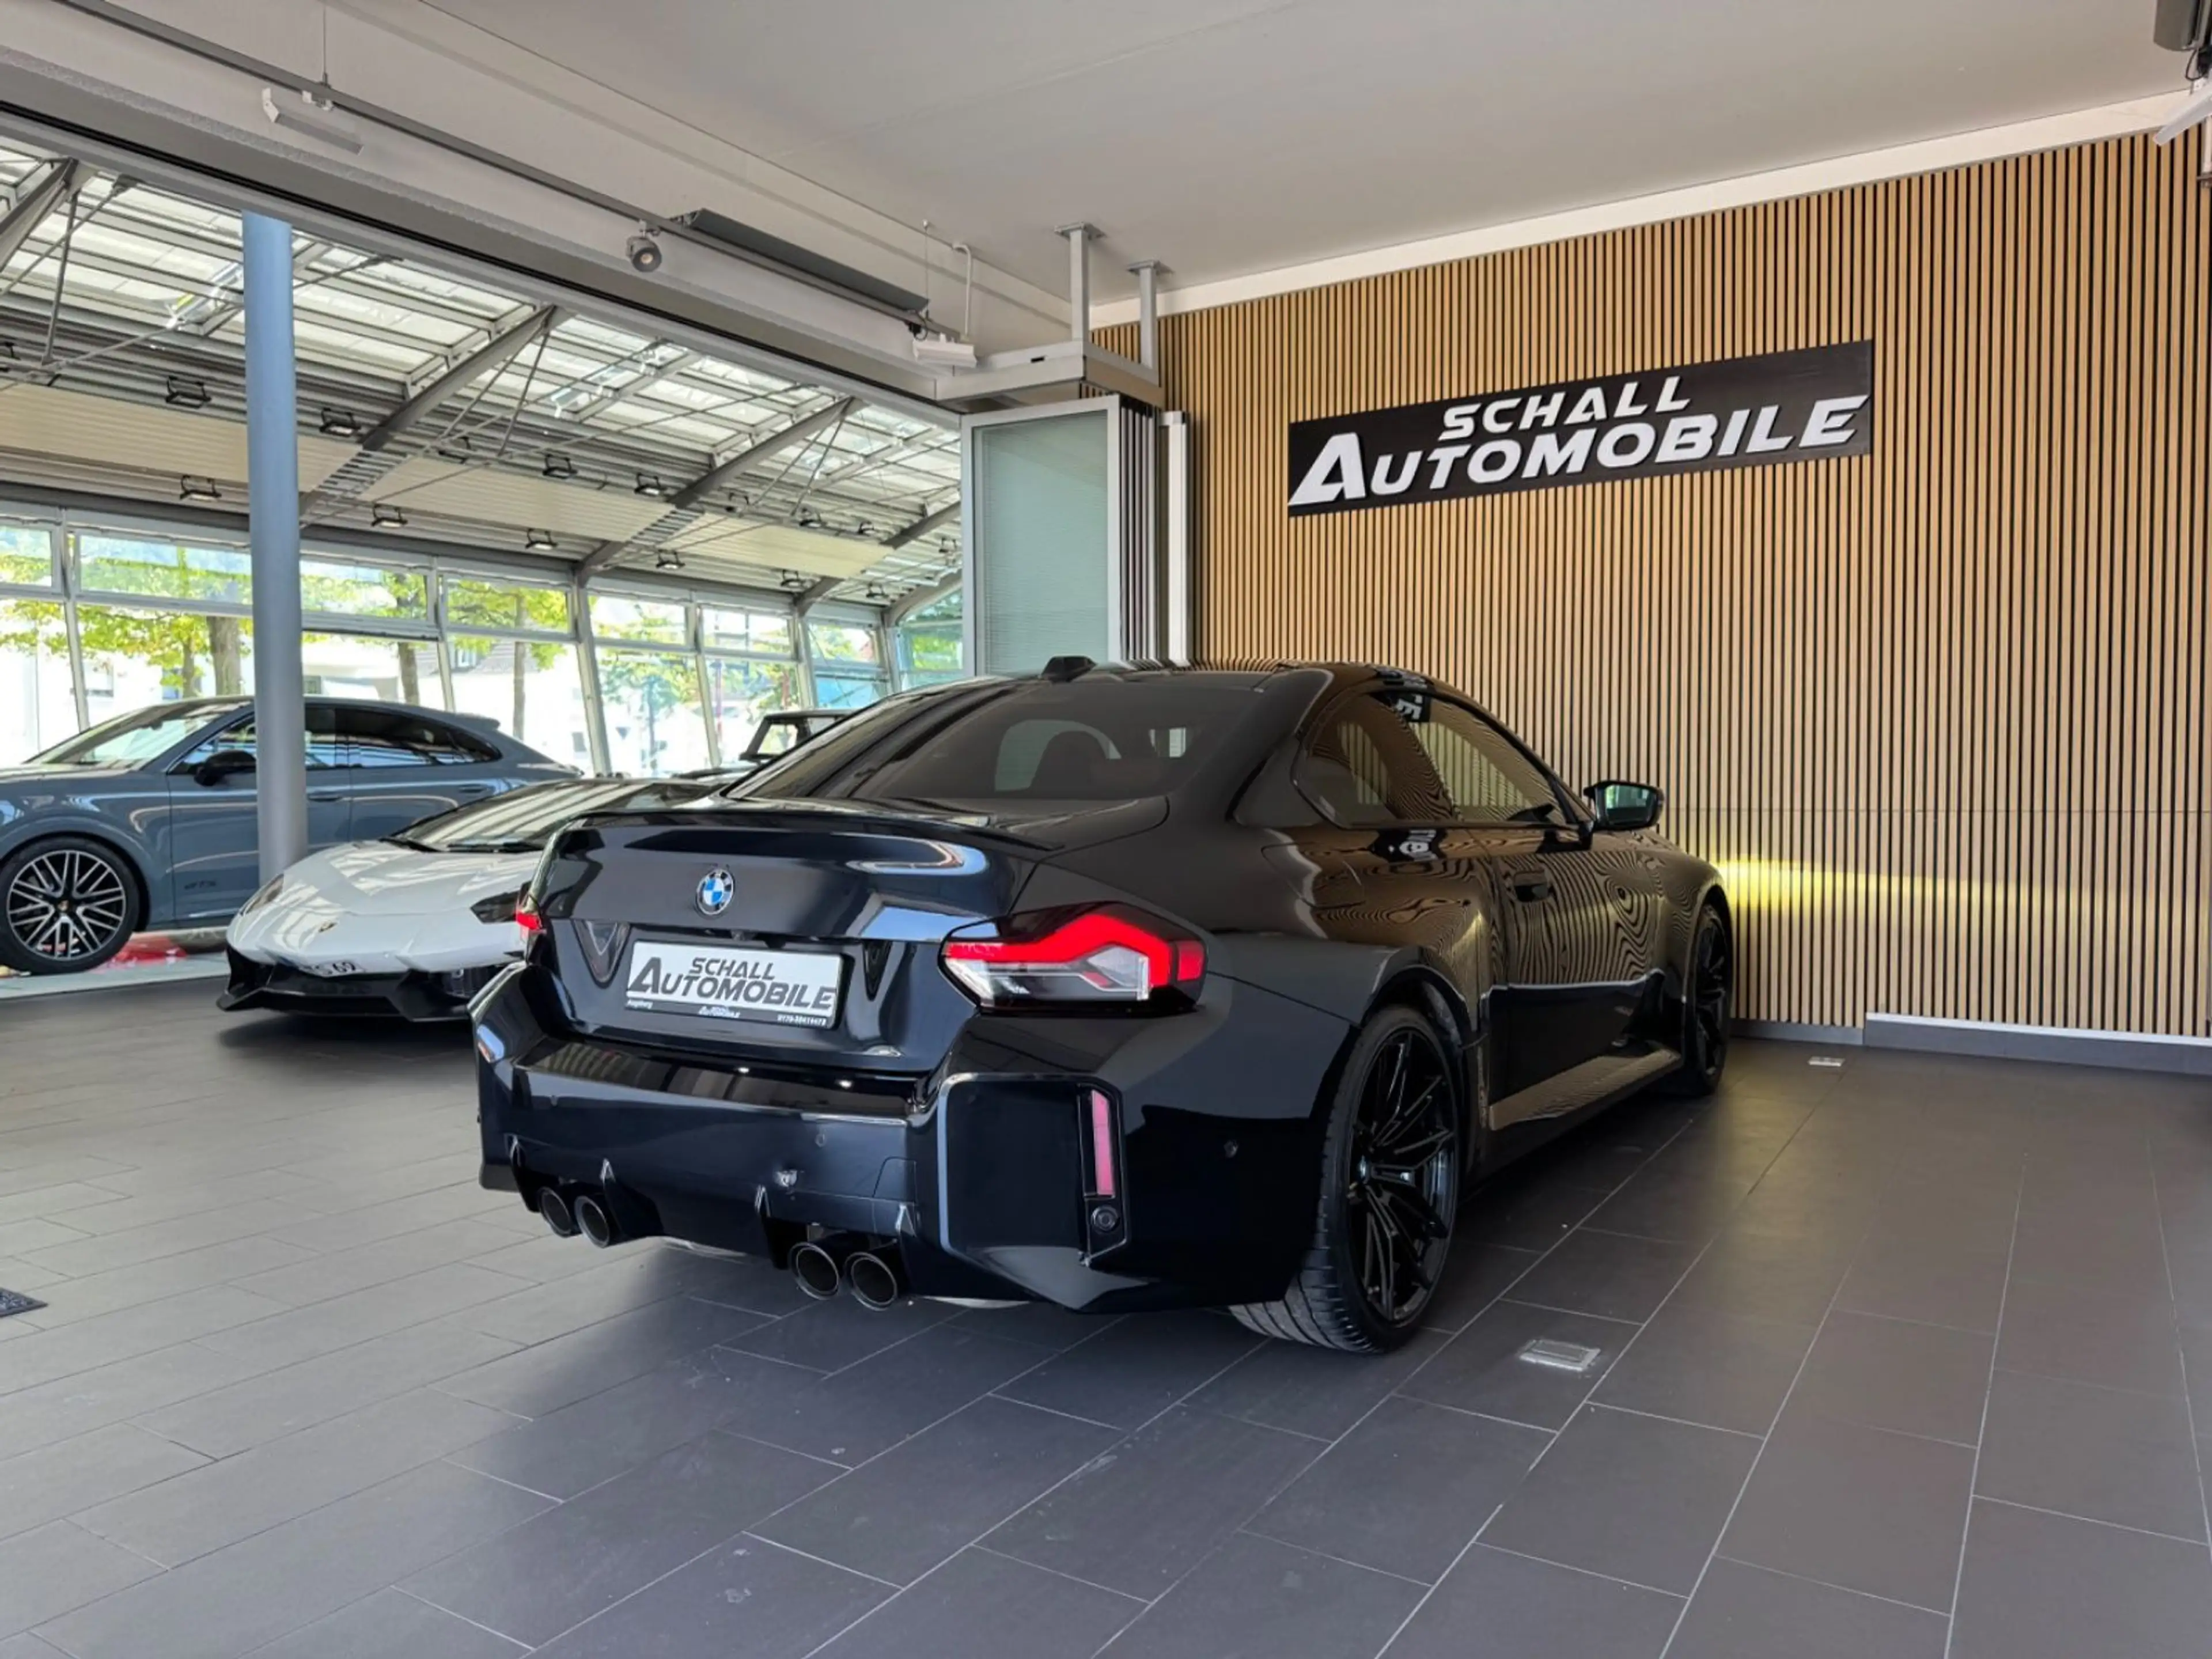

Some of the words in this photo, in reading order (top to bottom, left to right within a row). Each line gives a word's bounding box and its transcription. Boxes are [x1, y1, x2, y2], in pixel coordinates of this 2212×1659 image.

[1437, 375, 1694, 441] SCHALL
[1287, 394, 1870, 506] AUTOMOBILE
[628, 956, 838, 1010] AUTOMOBILE
[688, 957, 775, 980] SCHALL
